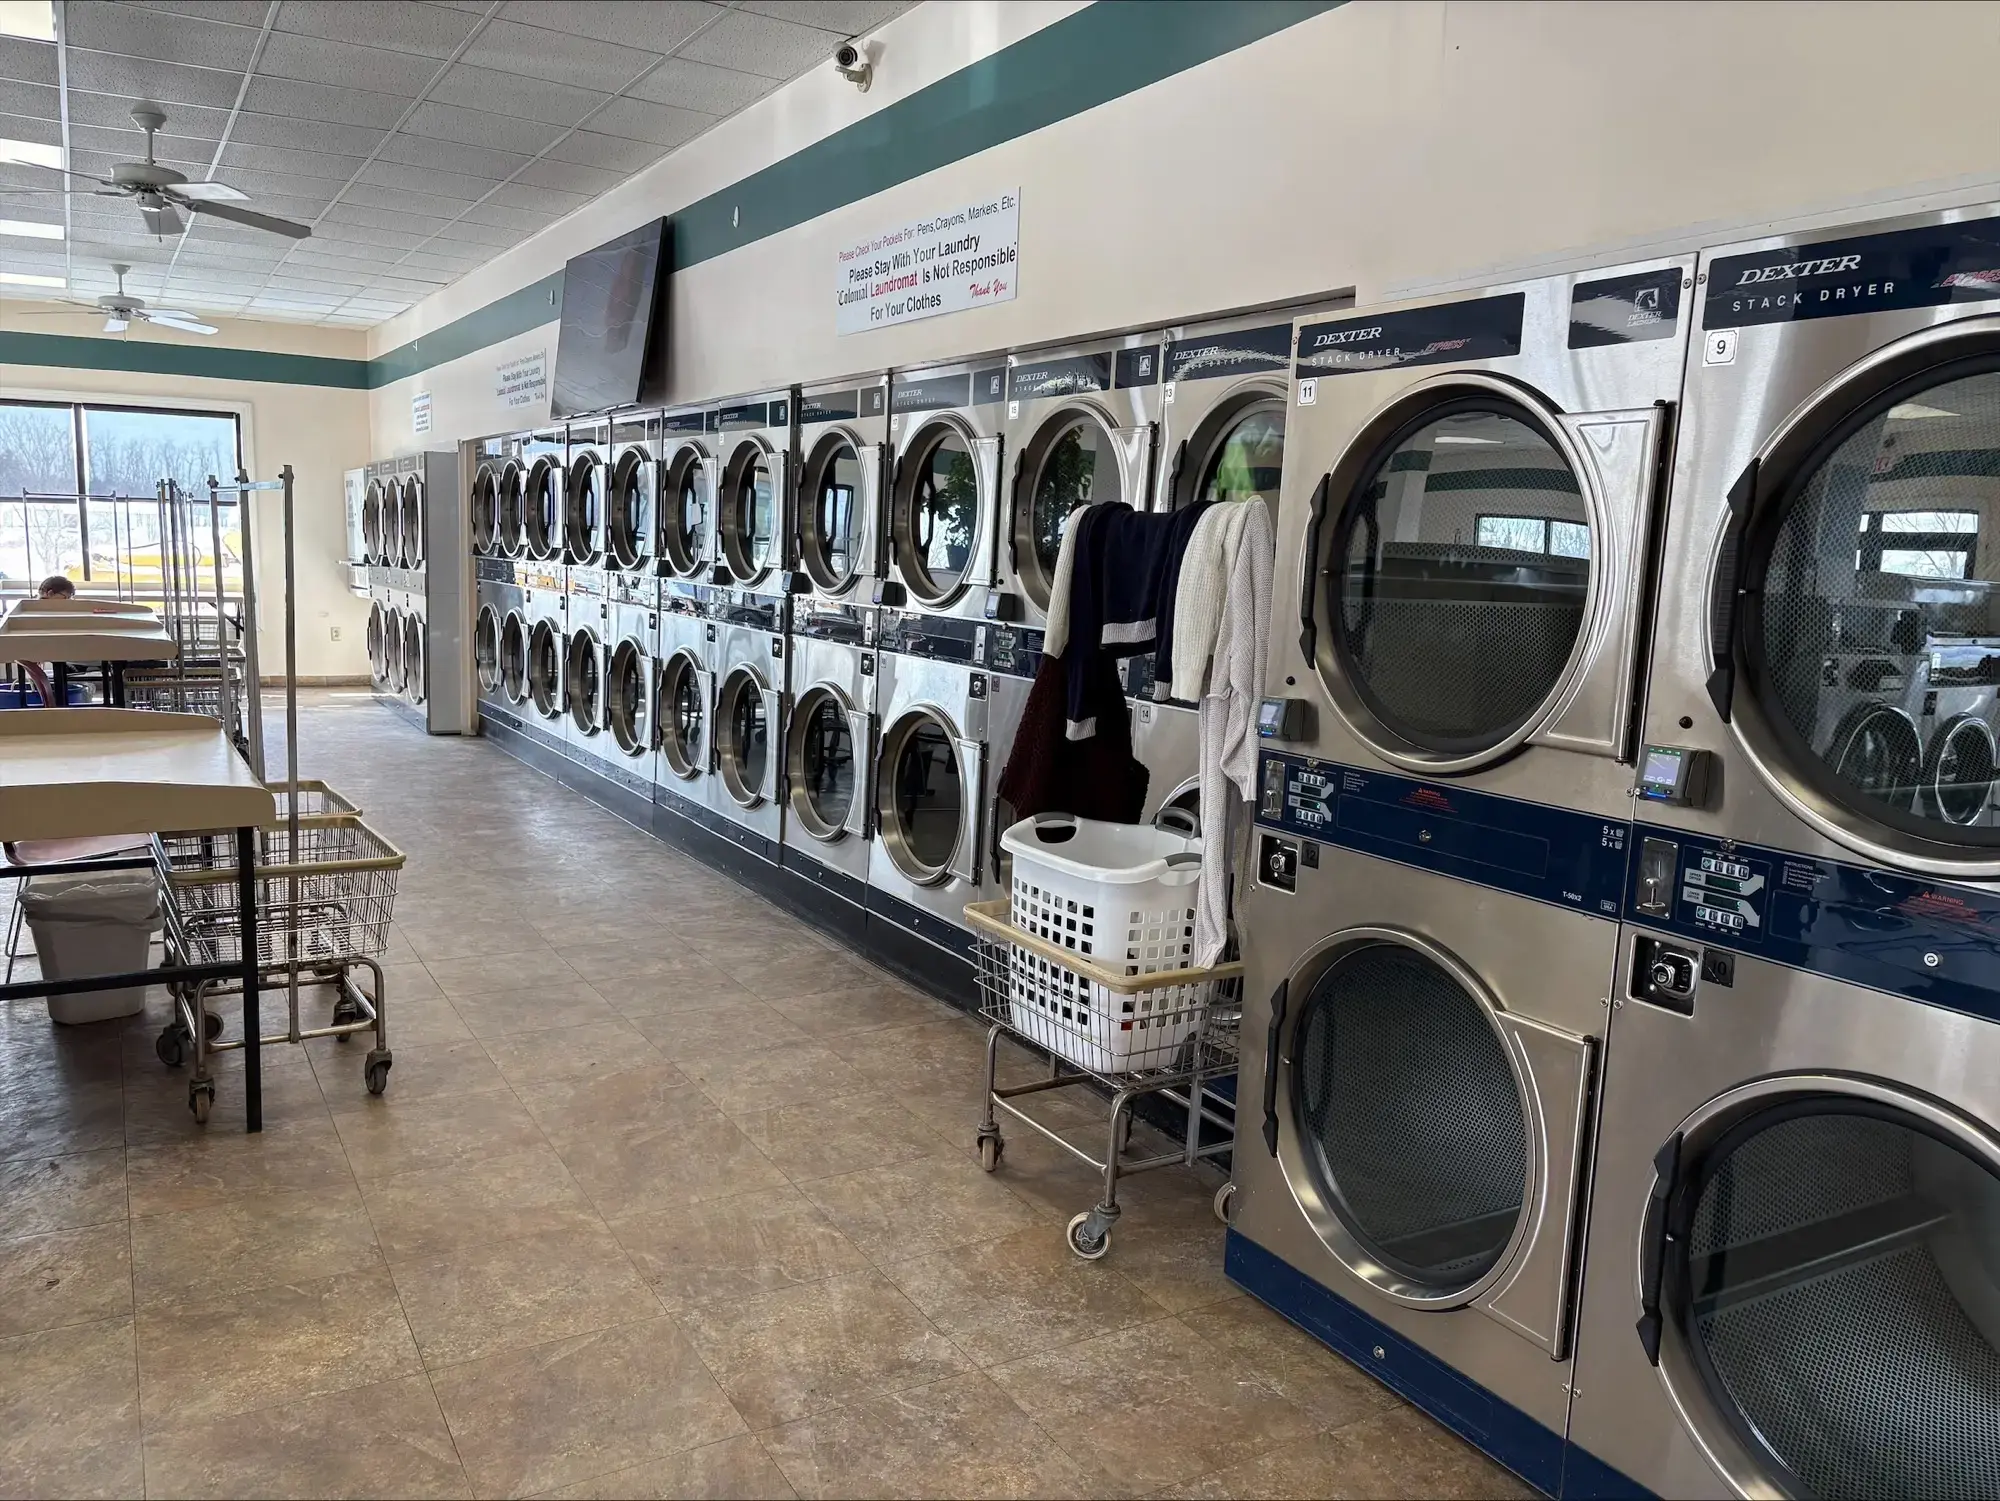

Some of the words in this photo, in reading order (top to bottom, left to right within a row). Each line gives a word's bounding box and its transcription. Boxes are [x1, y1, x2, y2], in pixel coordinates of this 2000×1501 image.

[871, 239, 882, 252] Your
[968, 203, 1000, 220] Markers,
[1002, 195, 1016, 210] Etc.
[849, 268, 873, 283] Please
[874, 260, 891, 276] Stay
[892, 251, 911, 271] With
[913, 246, 936, 264] Your
[938, 233, 980, 257] Laundry
[871, 270, 918, 298] Laundromat
[922, 267, 931, 284] Is
[933, 263, 950, 281] Not
[952, 246, 1016, 276] Responsible
[1735, 254, 1862, 286] DEXTER
[970, 281, 991, 299] Thank
[992, 278, 1008, 297] You
[1732, 292, 1804, 312] STACK
[1819, 281, 1895, 302] DRYER
[870, 306, 883, 321] For
[885, 302, 904, 318] Your
[906, 293, 942, 313] Clothes
[1628, 310, 1663, 321] DEXTER
[1313, 326, 1383, 347] DEXTER
[1174, 346, 1219, 360] DEXTER
[1716, 339, 1726, 354] 9
[1311, 353, 1351, 366] STACK
[1359, 347, 1401, 360] DRYER
[1015, 371, 1048, 383] DEXTER
[897, 388, 924, 398] DEXTER
[1165, 388, 1173, 398] 13
[1302, 385, 1313, 397] 11
[1142, 710, 1149, 718] 14
[1602, 825, 1609, 835] 5
[1601, 837, 1608, 847] 5
[1305, 848, 1317, 860] 12
[1562, 890, 1582, 902] T-50X2
[1931, 893, 1964, 906] WARNING
